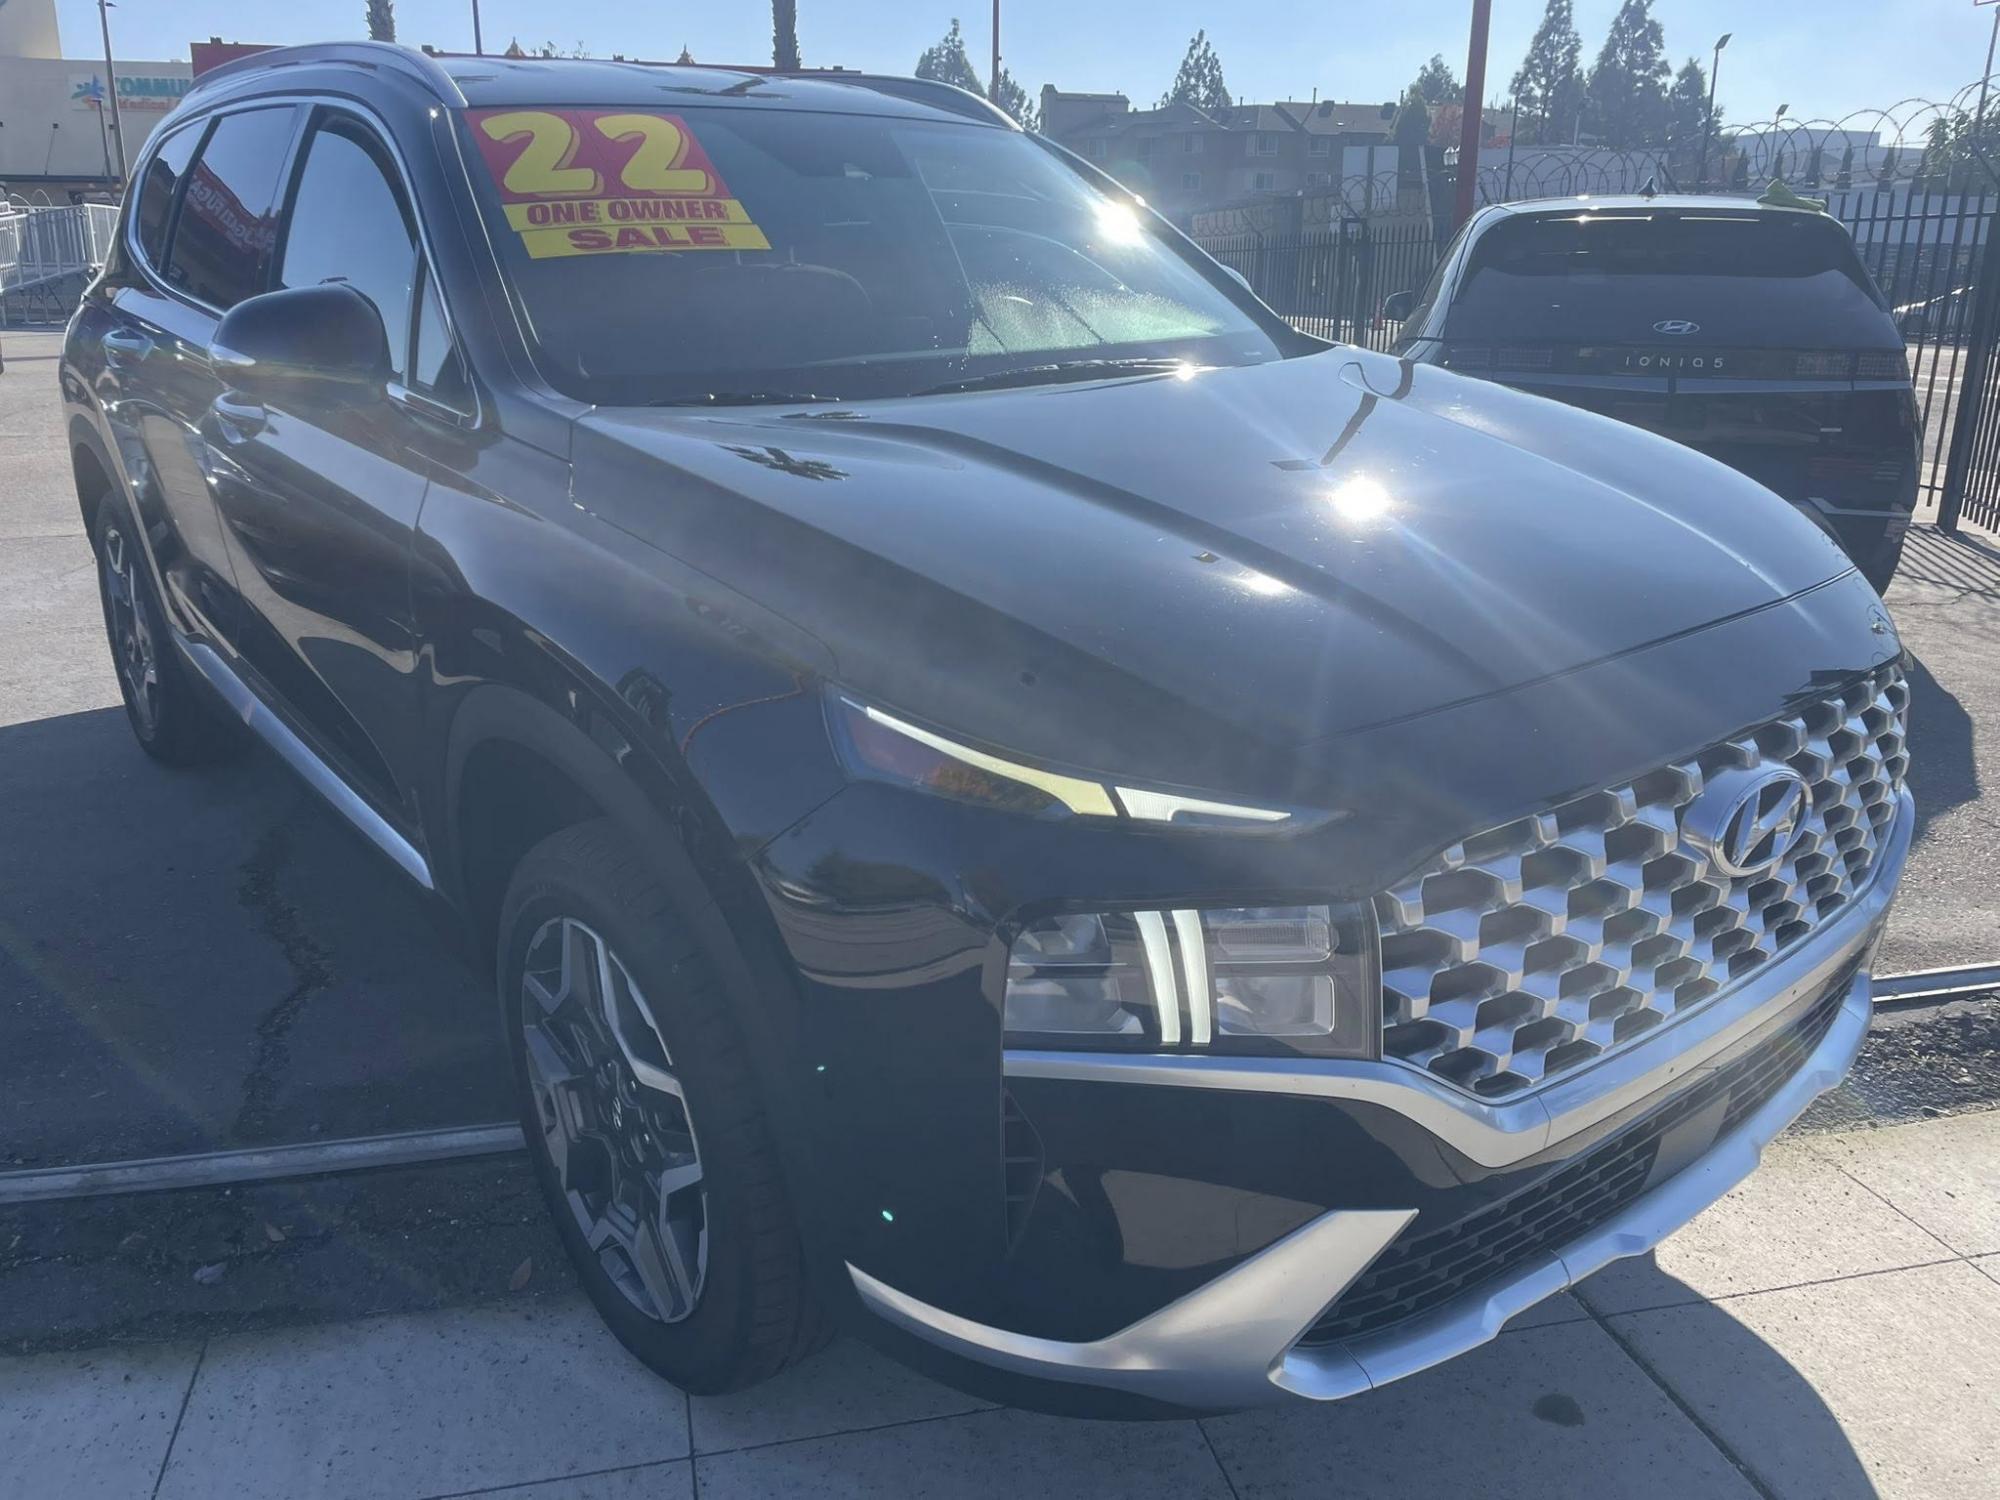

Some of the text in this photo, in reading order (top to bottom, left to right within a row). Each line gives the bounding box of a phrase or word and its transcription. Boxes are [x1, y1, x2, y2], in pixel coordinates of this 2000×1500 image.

[480, 111, 715, 196] 22
[527, 200, 729, 226] ONE OWNER
[567, 226, 729, 250] SALE
